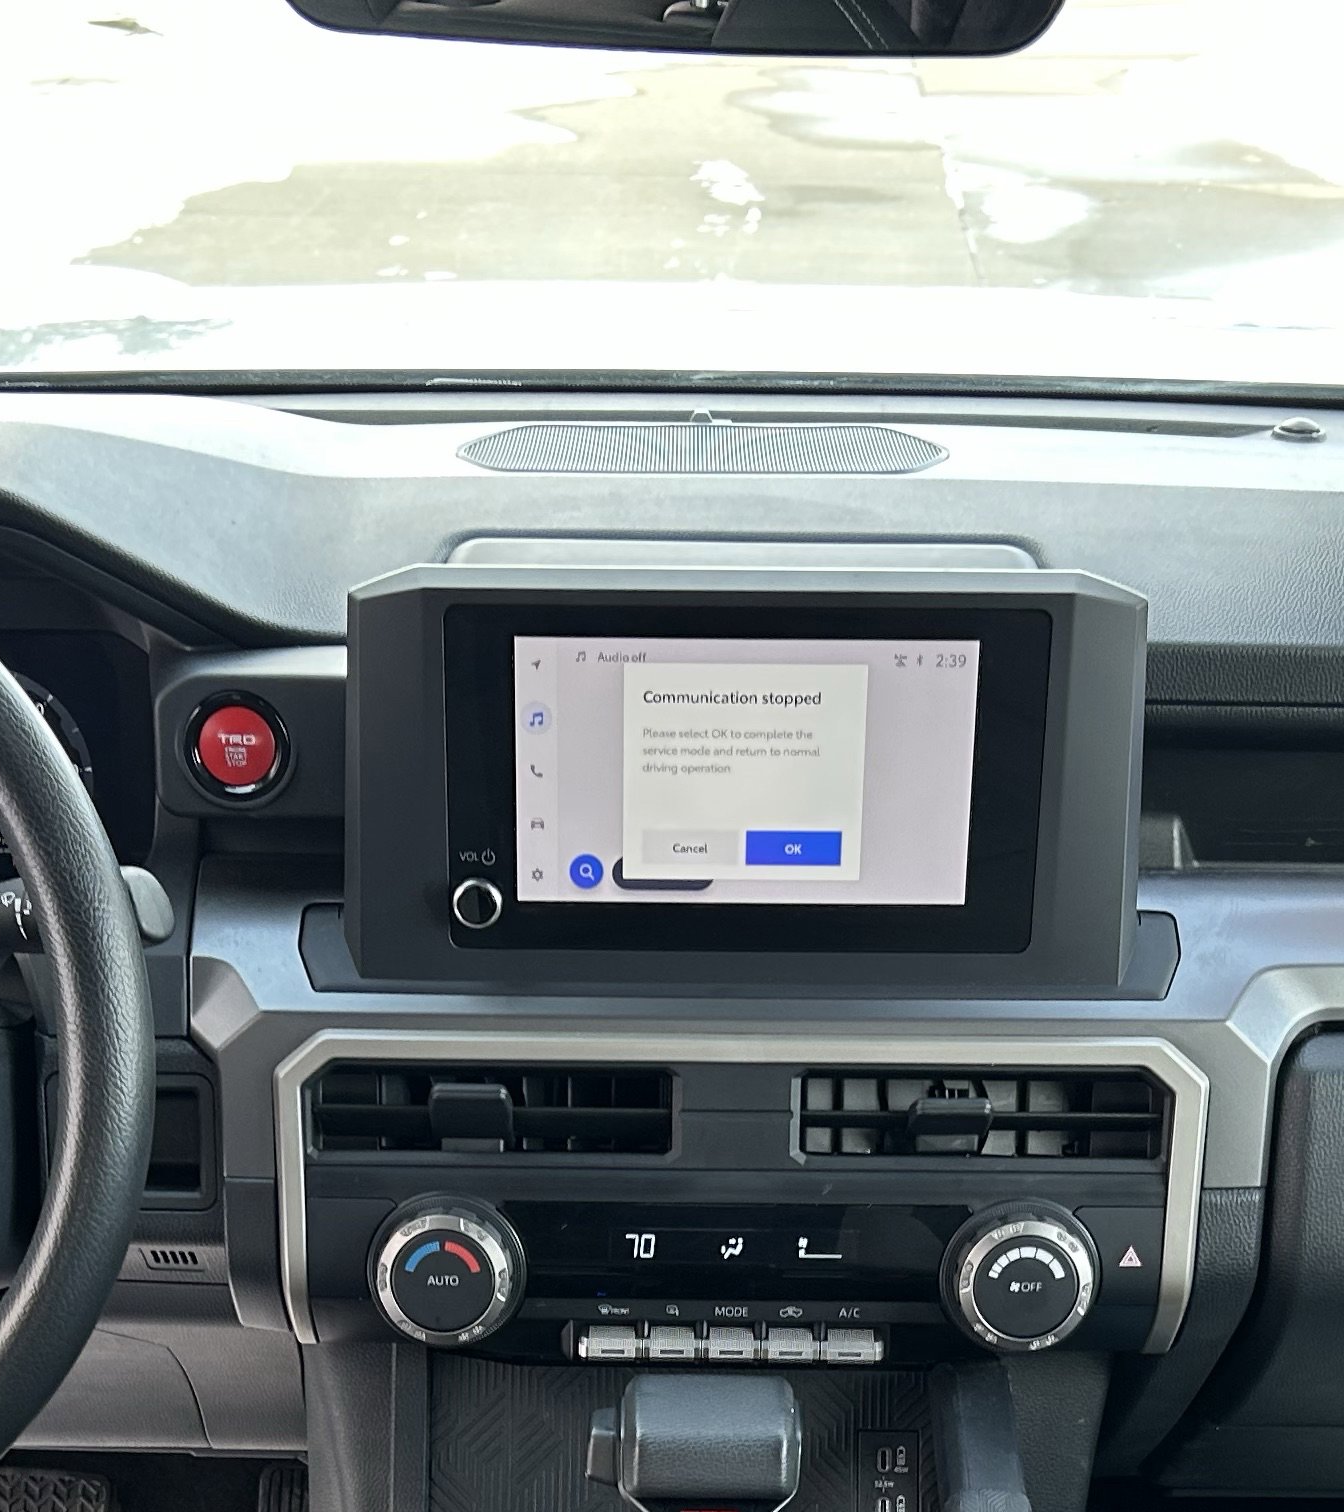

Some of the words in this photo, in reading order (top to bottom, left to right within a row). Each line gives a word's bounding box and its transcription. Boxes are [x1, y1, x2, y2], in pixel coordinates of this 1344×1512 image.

[597, 650, 629, 663] Audio
[631, 650, 647, 663] off
[935, 653, 967, 668] 2:39
[643, 690, 757, 704] Communication
[761, 691, 822, 708] stopped
[217, 732, 256, 746] TRD
[642, 728, 676, 739] Please
[679, 728, 708, 739] select
[712, 729, 728, 739] OK
[731, 730, 741, 739] to
[744, 729, 793, 741] complete
[796, 729, 813, 740] the
[642, 747, 678, 756] service
[680, 746, 710, 756] mode
[713, 746, 733, 756] and
[736, 747, 767, 756] return
[770, 747, 781, 756] to
[784, 747, 820, 757] normal
[642, 763, 677, 775] driving
[672, 842, 708, 855] Cancel
[784, 843, 802, 855] OK
[459, 850, 479, 863] VOL
[625, 1233, 656, 1258] 70
[427, 1275, 459, 1287] AUTO
[1021, 1281, 1043, 1292] OFF
[714, 1306, 749, 1317] MODE
[838, 1307, 861, 1318] A/C
